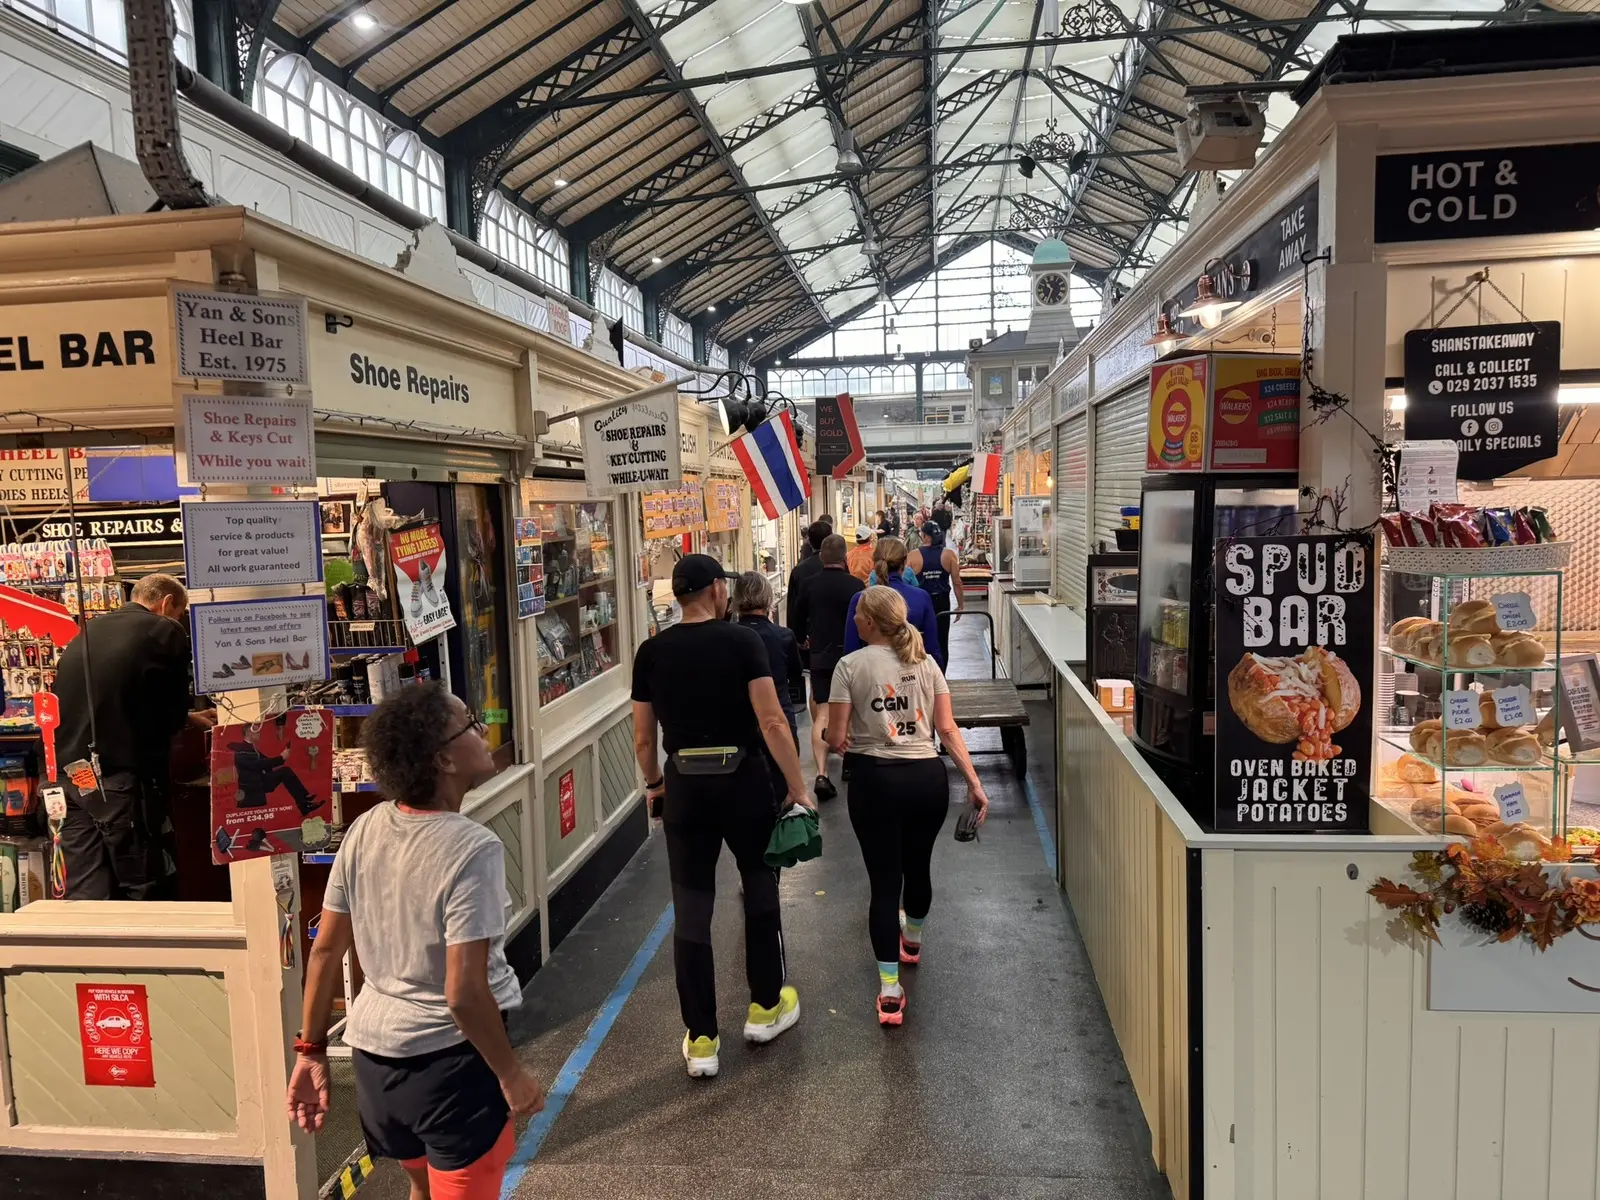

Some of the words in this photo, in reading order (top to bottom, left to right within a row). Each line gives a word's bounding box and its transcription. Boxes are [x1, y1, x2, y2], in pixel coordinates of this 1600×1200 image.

[1411, 160, 1484, 190] HOT
[1494, 159, 1518, 186] &
[1408, 194, 1517, 224] COLD
[1281, 205, 1305, 241] TAKE
[1279, 233, 1307, 272] AWAY
[182, 301, 224, 321] Yan
[229, 306, 247, 322] &
[252, 308, 296, 327] Sons
[200, 327, 244, 347] Heel
[250, 331, 284, 349] Bar
[1431, 332, 1535, 353] SHANSTAKEAWAY
[60, 330, 156, 368] BAR
[199, 352, 237, 370] Est.
[244, 355, 287, 373] 1975
[1435, 363, 1463, 377] CALL
[1467, 361, 1476, 375] &
[1479, 358, 1531, 374] COLLECT
[350, 353, 401, 391] Shoe
[406, 365, 470, 404] Repairs
[1257, 369, 1268, 378] BIG
[1275, 383, 1297, 392] CHEESE
[1446, 379, 1470, 393] 029
[1473, 376, 1504, 391] 2037
[1508, 374, 1538, 389] 1535
[1221, 401, 1250, 411] WALKERS
[1450, 403, 1496, 418] FOLLOW
[1499, 401, 1514, 415] US
[203, 411, 239, 425] Shoe
[244, 413, 297, 428] Repairs
[594, 405, 628, 432] Quality
[1275, 411, 1287, 420] SALT
[210, 430, 223, 443] &
[228, 430, 263, 446] Keys
[266, 432, 293, 444] Cut
[605, 428, 628, 442] SHOE
[630, 424, 666, 440] REPAIRS
[631, 439, 639, 451] &
[1456, 438, 1483, 452] AILY
[1485, 435, 1542, 450] SPECIALS
[198, 454, 242, 468] While
[247, 457, 272, 470] you
[276, 456, 307, 468] wait
[610, 453, 628, 467] KEY
[628, 450, 666, 464] CUTTING
[10, 468, 63, 481] CUTTING
[611, 469, 669, 485] WHILE-U-WAIT
[32, 488, 69, 500] HEELS
[42, 522, 83, 538] SHOE
[90, 518, 164, 535] REPAIRS
[171, 517, 183, 532] &
[225, 517, 244, 526] Top
[246, 516, 277, 526] quality
[210, 532, 242, 541] service
[244, 532, 252, 540] &
[255, 531, 295, 541] products
[400, 532, 410, 544] NO
[410, 528, 428, 542] MORE
[218, 548, 232, 556] for
[234, 548, 258, 557] great
[260, 546, 289, 555] value!
[394, 542, 417, 558] TYING
[415, 537, 439, 552] LACES!
[208, 565, 220, 573] All
[222, 564, 246, 572] work
[248, 561, 300, 573] guaranteed
[1225, 541, 1366, 595] SPUD
[255, 612, 287, 620] Facebook
[423, 612, 435, 624] EASY
[1243, 595, 1346, 647] BAR
[220, 626, 242, 634] latest
[279, 623, 302, 631] offers
[215, 640, 231, 648] Yan
[235, 639, 242, 647] &
[245, 638, 266, 646] Sons
[269, 636, 289, 644] Heel
[293, 634, 307, 642] Bar
[901, 674, 915, 682] RUN
[871, 696, 908, 712] CGN
[896, 722, 916, 736] 25
[1230, 758, 1284, 777] OVEN
[1291, 758, 1356, 777] BAKED
[1237, 778, 1348, 801] JACKET
[225, 810, 253, 818] DUPLICATE
[226, 817, 245, 825] from
[247, 813, 274, 822] £34.95
[1237, 803, 1347, 822] POTATOES
[111, 994, 129, 1002] SILCA
